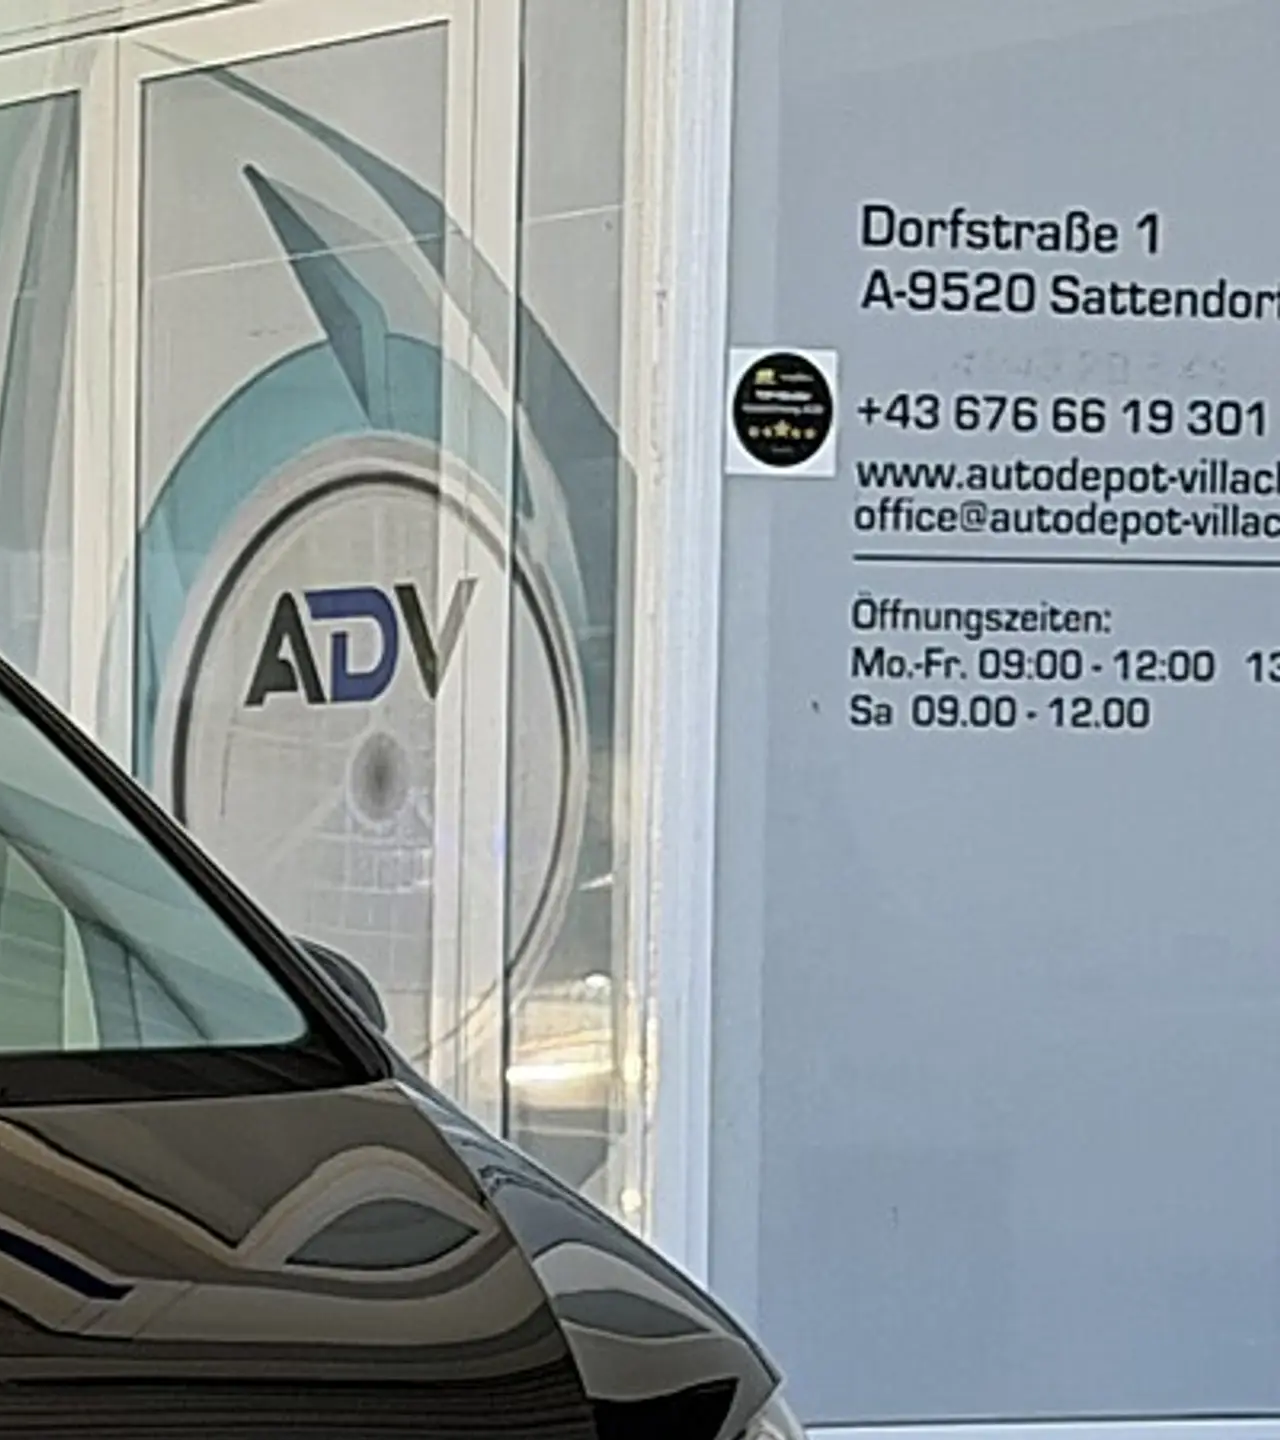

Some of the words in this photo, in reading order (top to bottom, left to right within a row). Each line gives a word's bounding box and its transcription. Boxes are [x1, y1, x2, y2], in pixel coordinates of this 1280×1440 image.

[862, 204, 1118, 254] Dorfstraße
[1136, 213, 1158, 255] 1
[861, 269, 1036, 313] A-9520
[857, 393, 940, 430] +43
[954, 394, 1038, 432] 676
[1052, 397, 1106, 434] 66
[1122, 399, 1174, 435] 19
[1187, 399, 1265, 437] 301
[856, 457, 1280, 502] www.autodepot-villac
[852, 591, 1112, 641] Öffnungszeiten:
[243, 577, 478, 707] ADV
[851, 646, 967, 681] Mo.-Fr.
[978, 648, 1083, 681] 09:00
[1113, 649, 1215, 683] 12:00
[850, 694, 893, 726] Sa
[912, 694, 1017, 728] 09.00
[1048, 696, 1150, 729] 12.00
